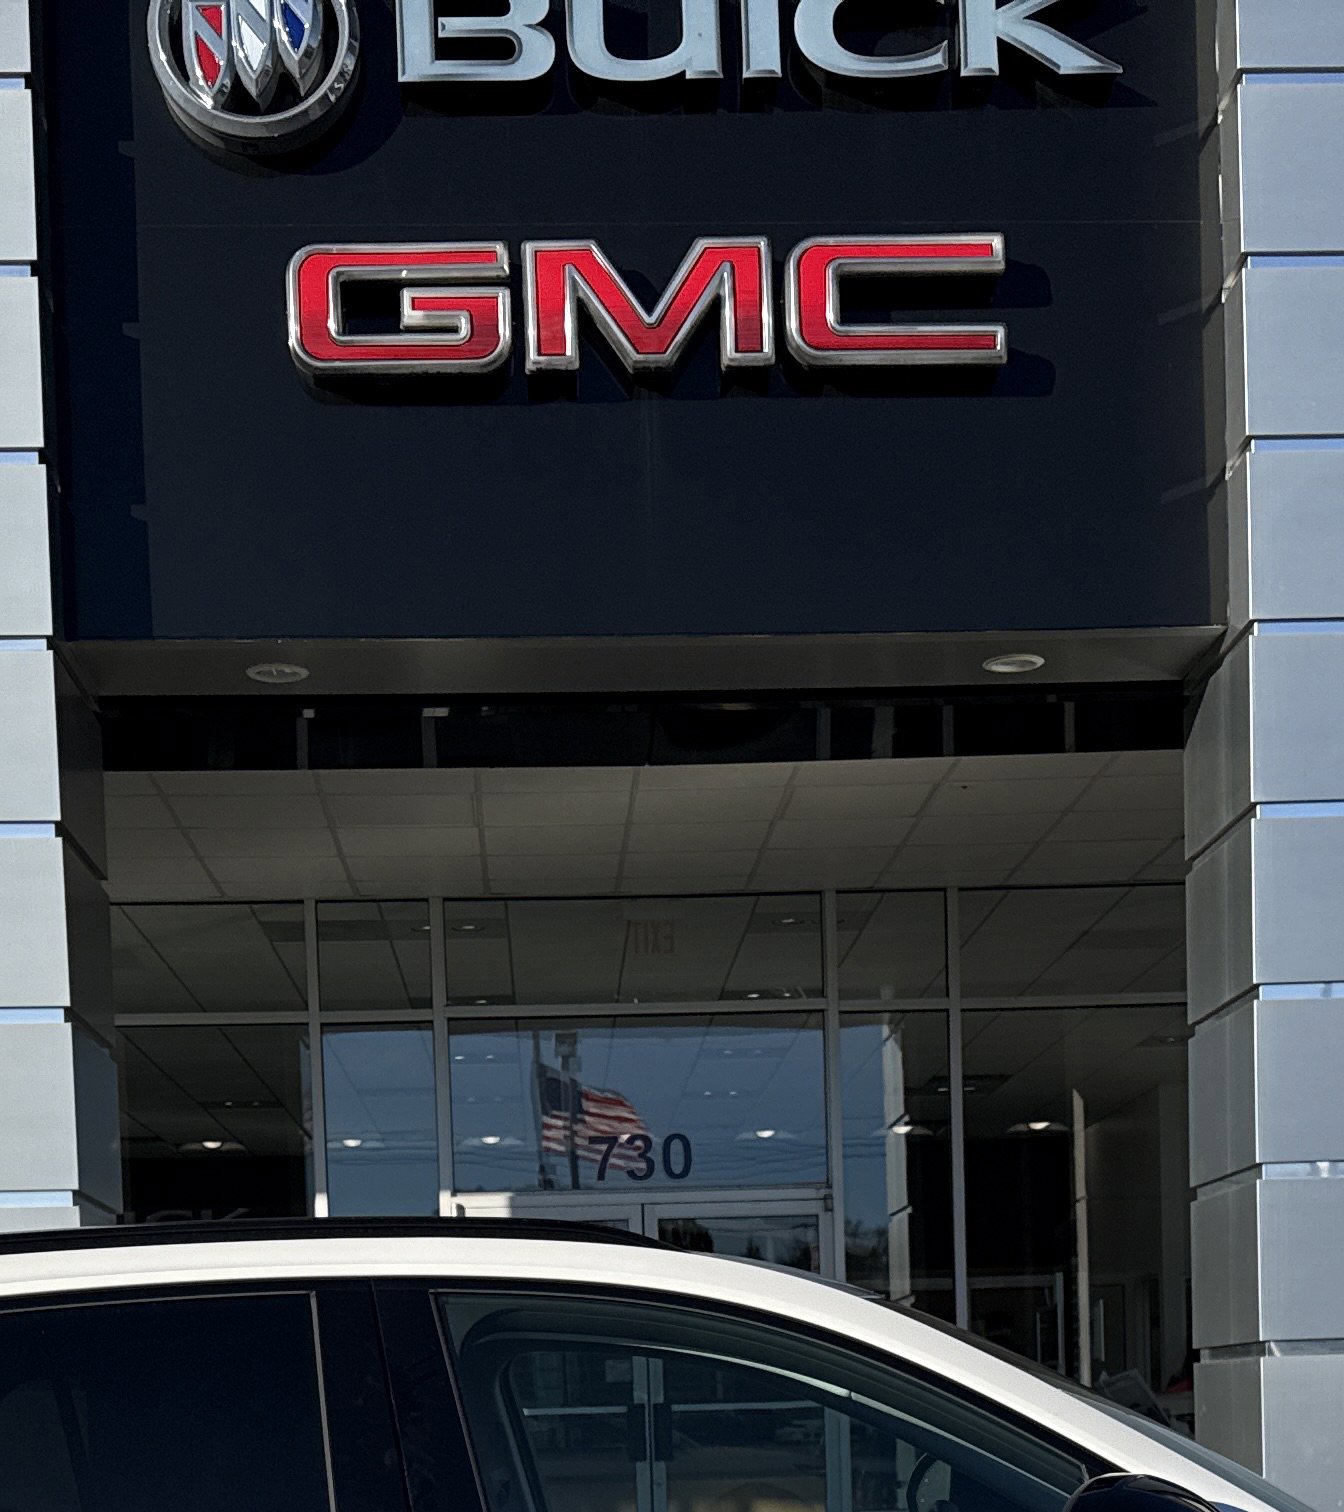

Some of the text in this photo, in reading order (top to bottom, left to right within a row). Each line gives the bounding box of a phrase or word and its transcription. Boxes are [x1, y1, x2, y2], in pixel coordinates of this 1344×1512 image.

[397, 0, 1123, 82] BUICK
[286, 232, 1008, 375] GMC
[588, 1133, 692, 1181] 730
